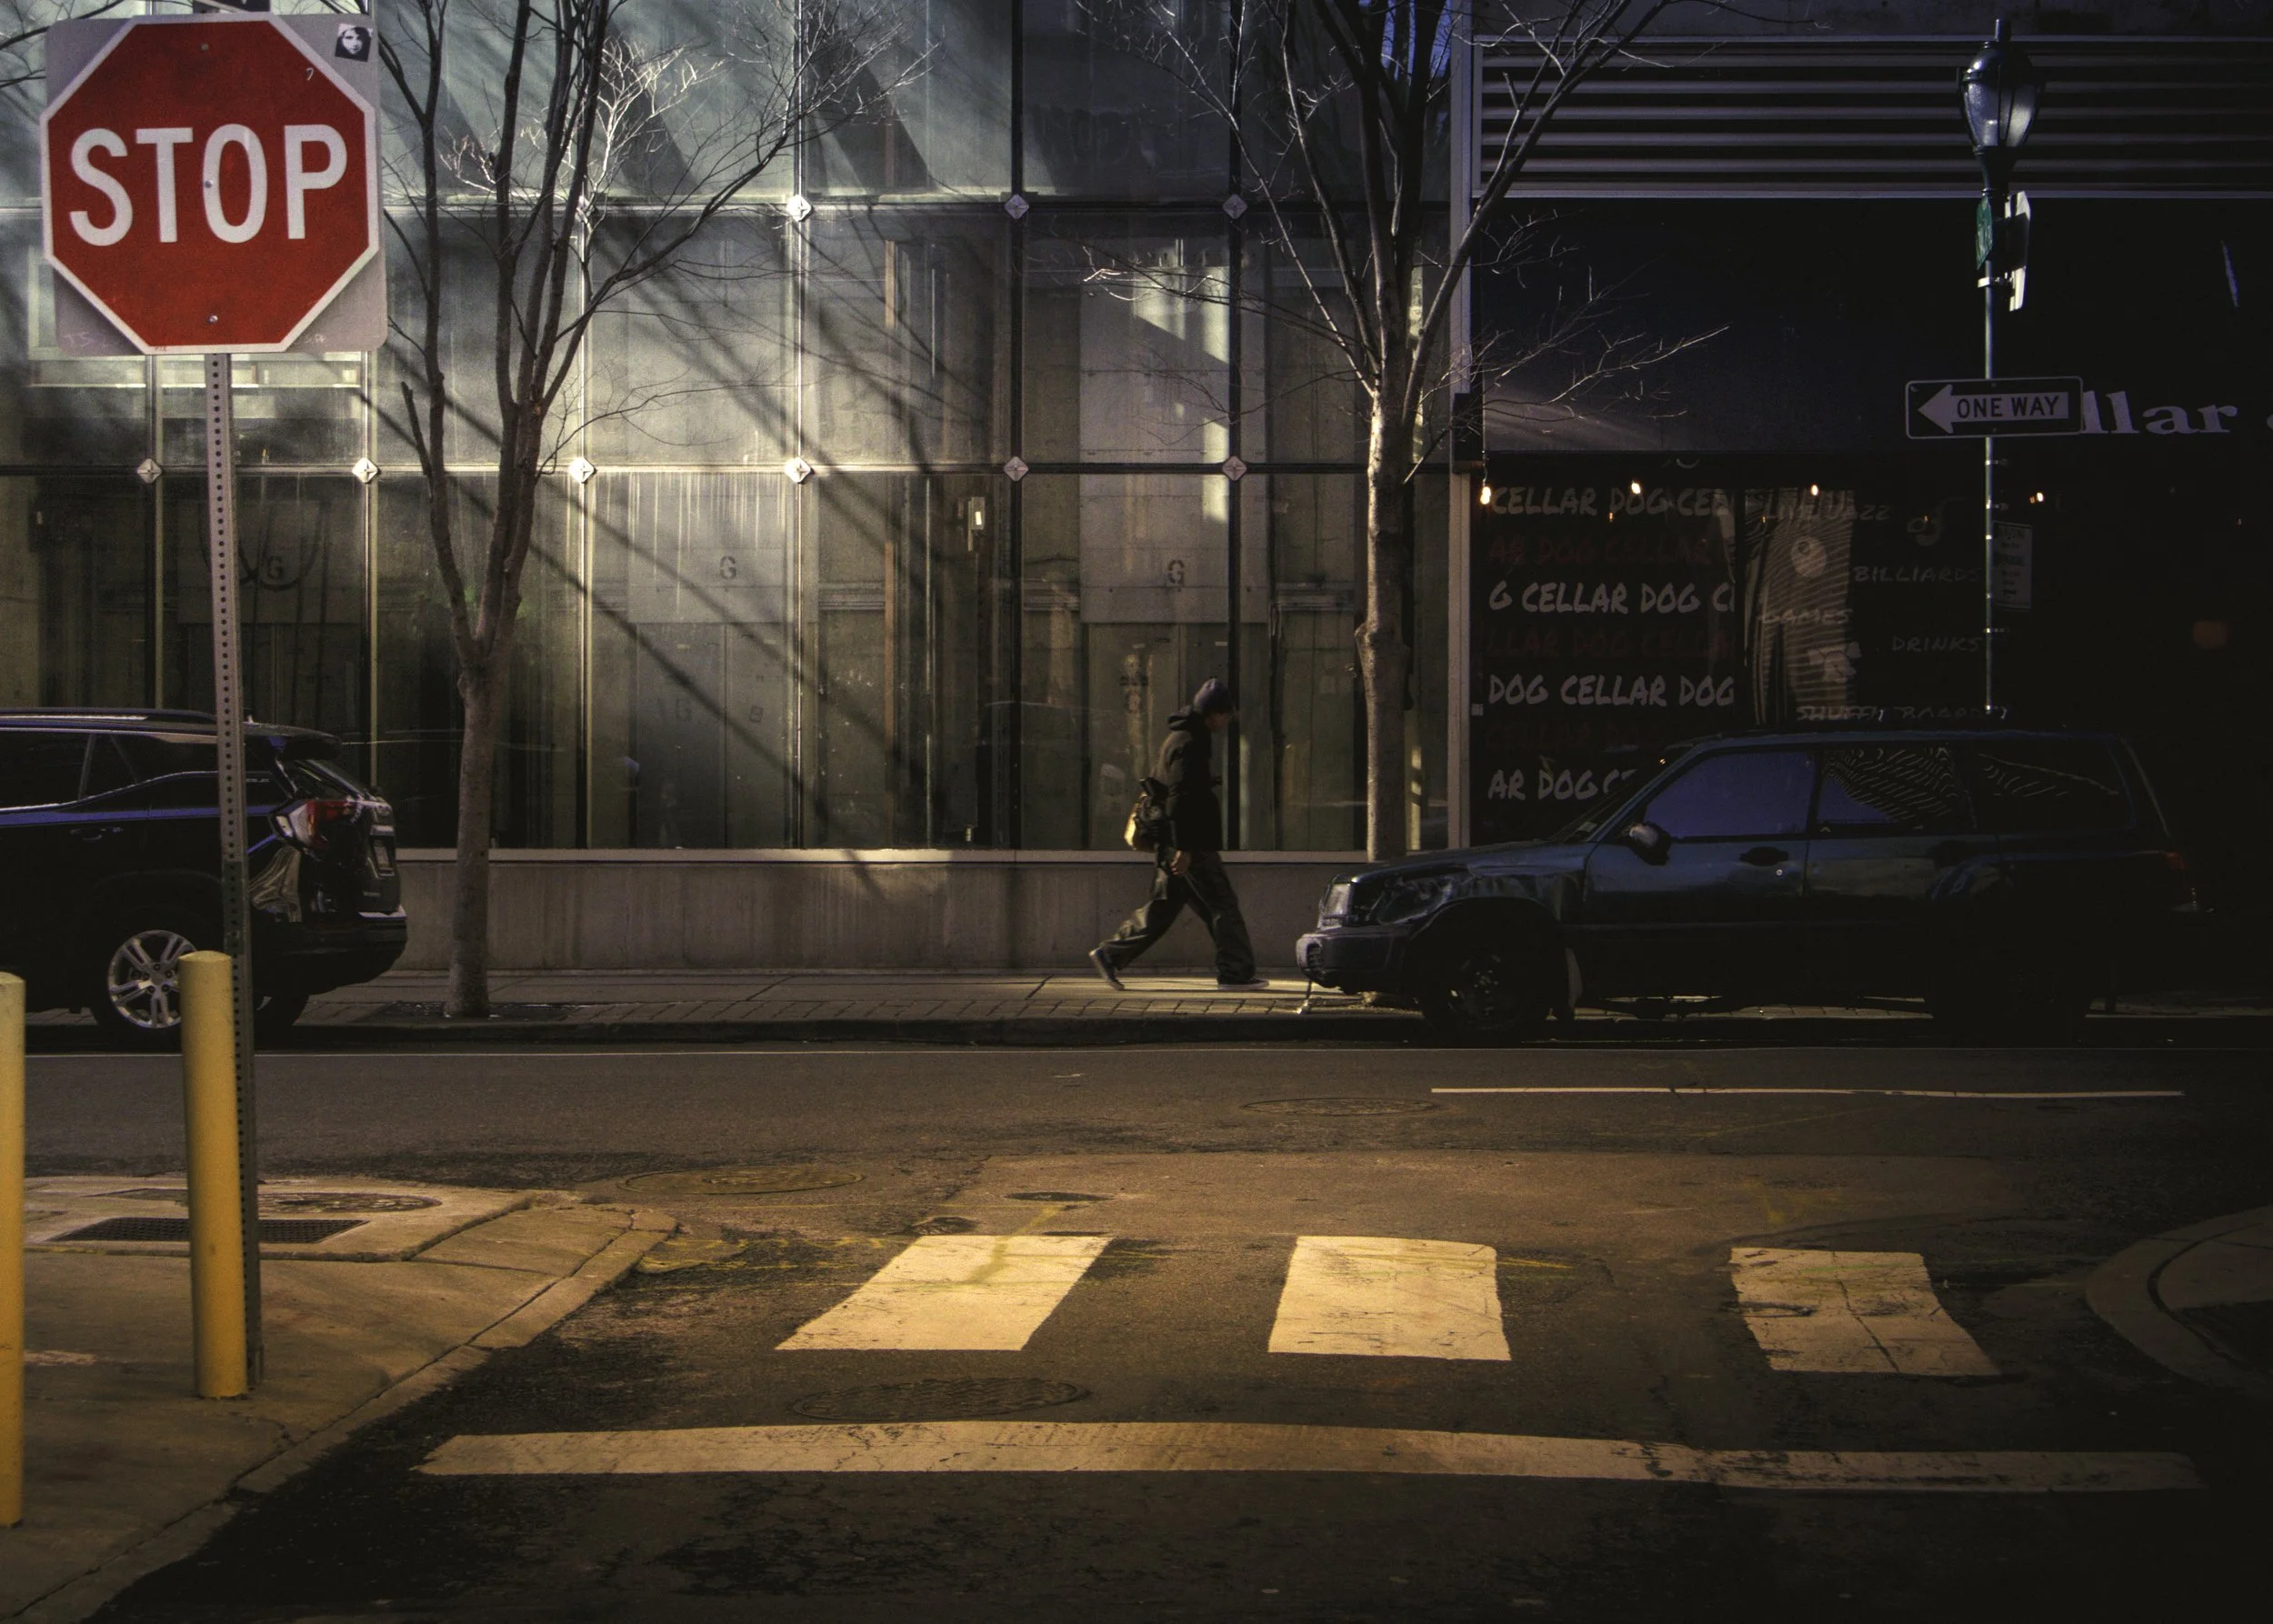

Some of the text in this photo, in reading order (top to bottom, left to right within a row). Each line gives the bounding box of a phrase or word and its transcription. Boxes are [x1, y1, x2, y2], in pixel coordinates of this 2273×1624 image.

[68, 124, 348, 246] STOP
[1957, 396, 2060, 419] ONE WAY
[1492, 486, 1597, 516] CELLAR
[1610, 486, 1669, 516] DOG
[1854, 566, 1983, 583] BILLIARDS
[1489, 580, 1735, 615] G CELLAR DOG C
[1891, 637, 1983, 653] DRINKS
[1488, 674, 1735, 707] DOG CELLAR DOG
[1487, 768, 1637, 801] AR DOG C
